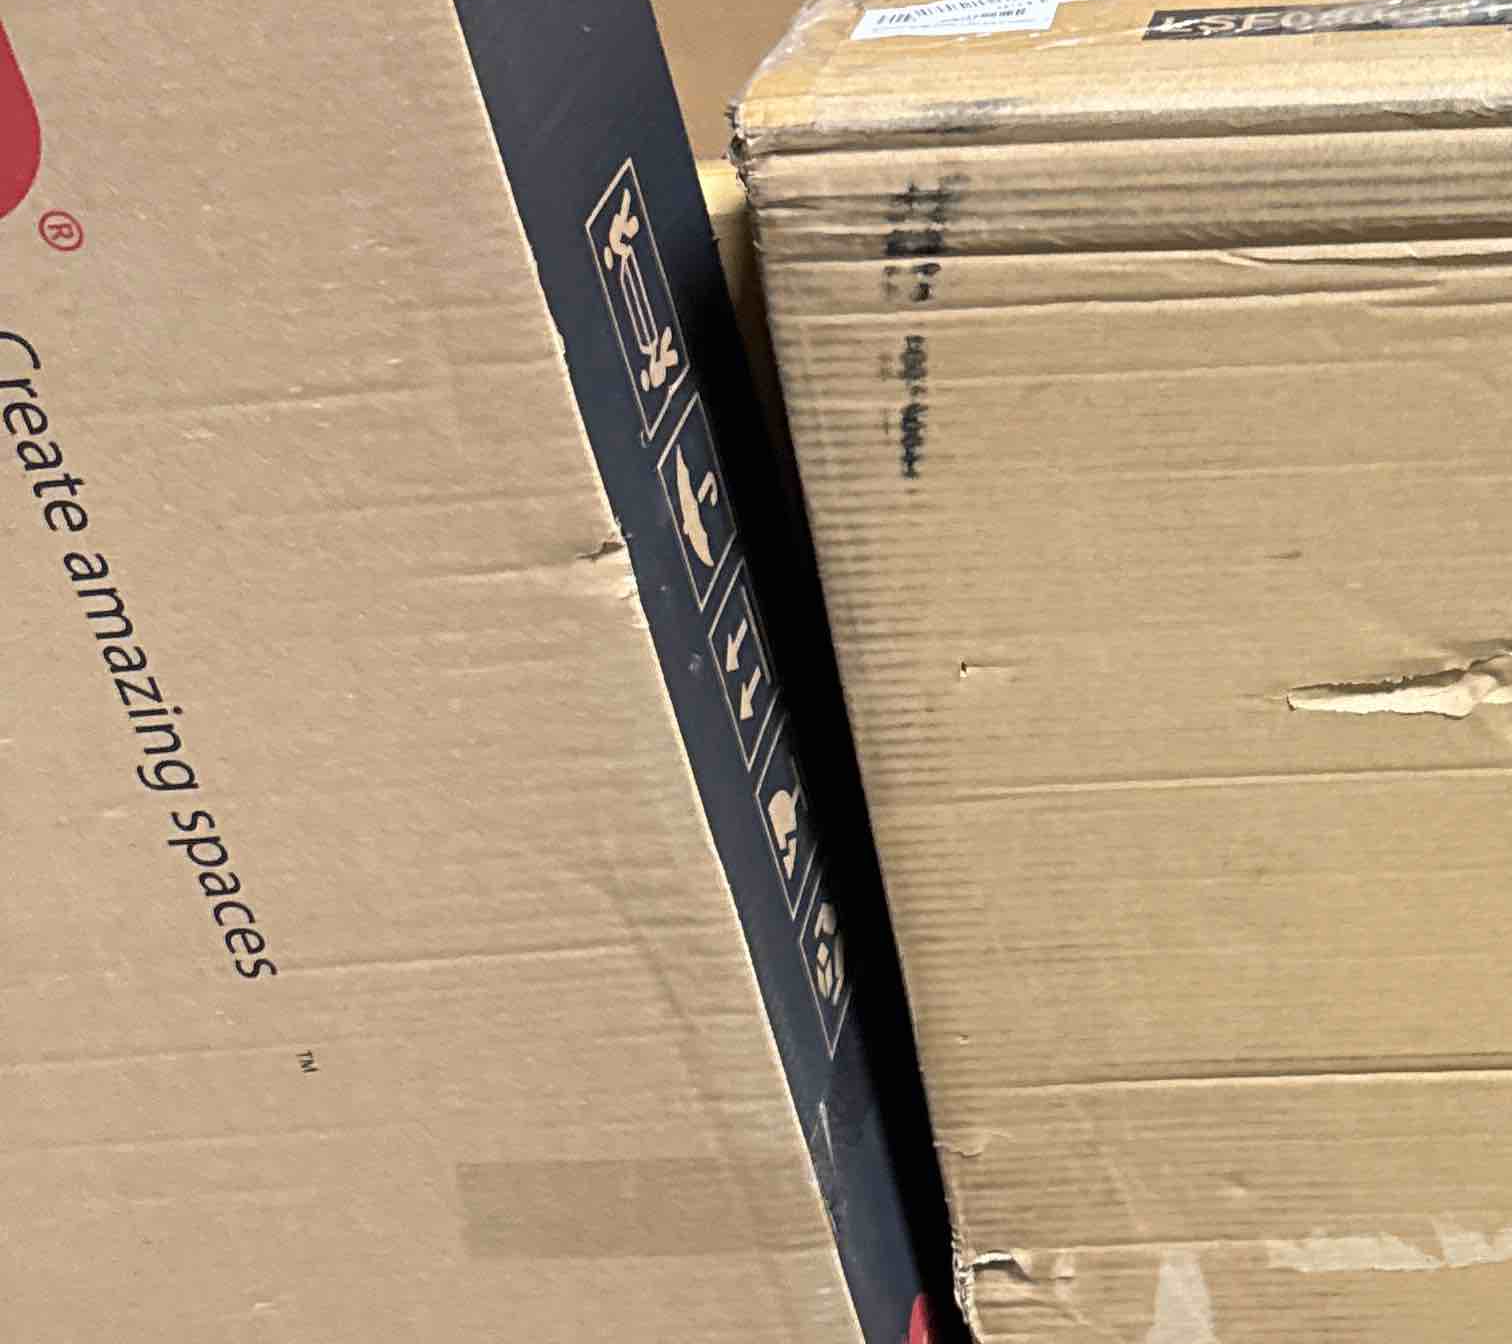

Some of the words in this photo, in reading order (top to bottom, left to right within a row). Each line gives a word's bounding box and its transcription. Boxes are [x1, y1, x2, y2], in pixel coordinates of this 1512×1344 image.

[0, 331, 88, 532] Create
[63, 552, 199, 792] amazing
[167, 809, 277, 979] spaces
